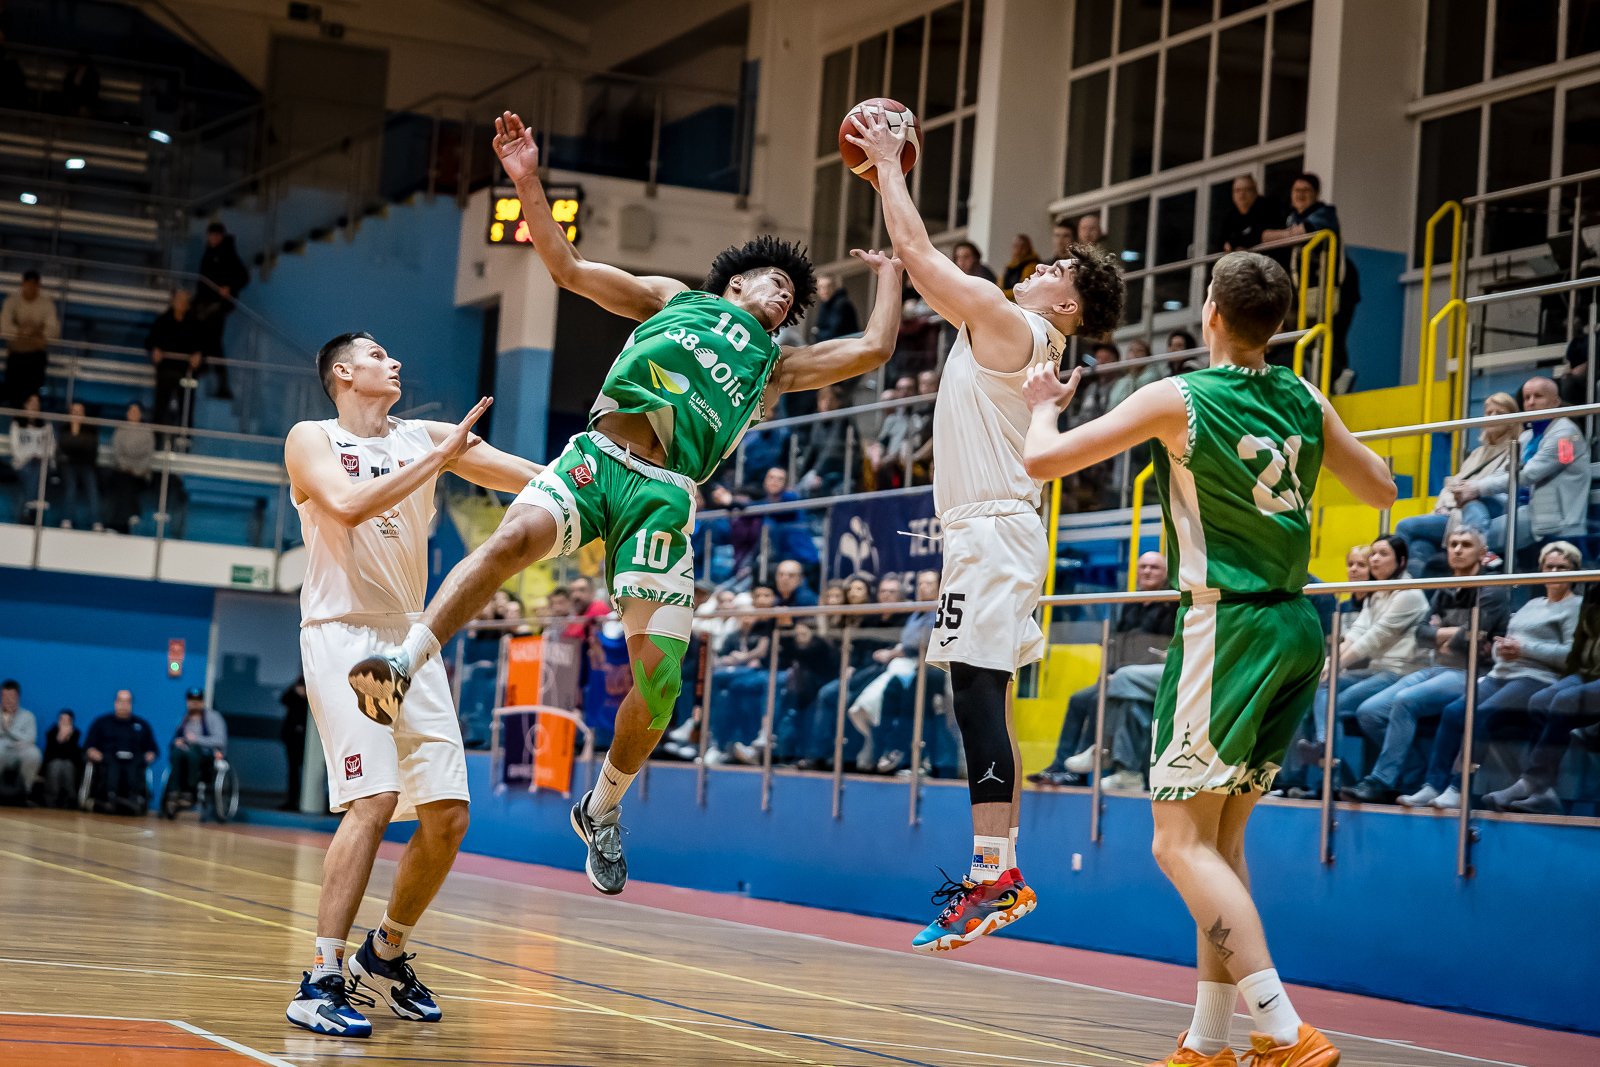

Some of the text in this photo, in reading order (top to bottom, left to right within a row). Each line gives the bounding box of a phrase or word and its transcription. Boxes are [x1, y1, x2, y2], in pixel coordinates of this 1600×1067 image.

[710, 312, 751, 352] 10
[663, 329, 745, 407] Q8 Oils
[1237, 433, 1304, 516] 21
[631, 528, 673, 570] 10
